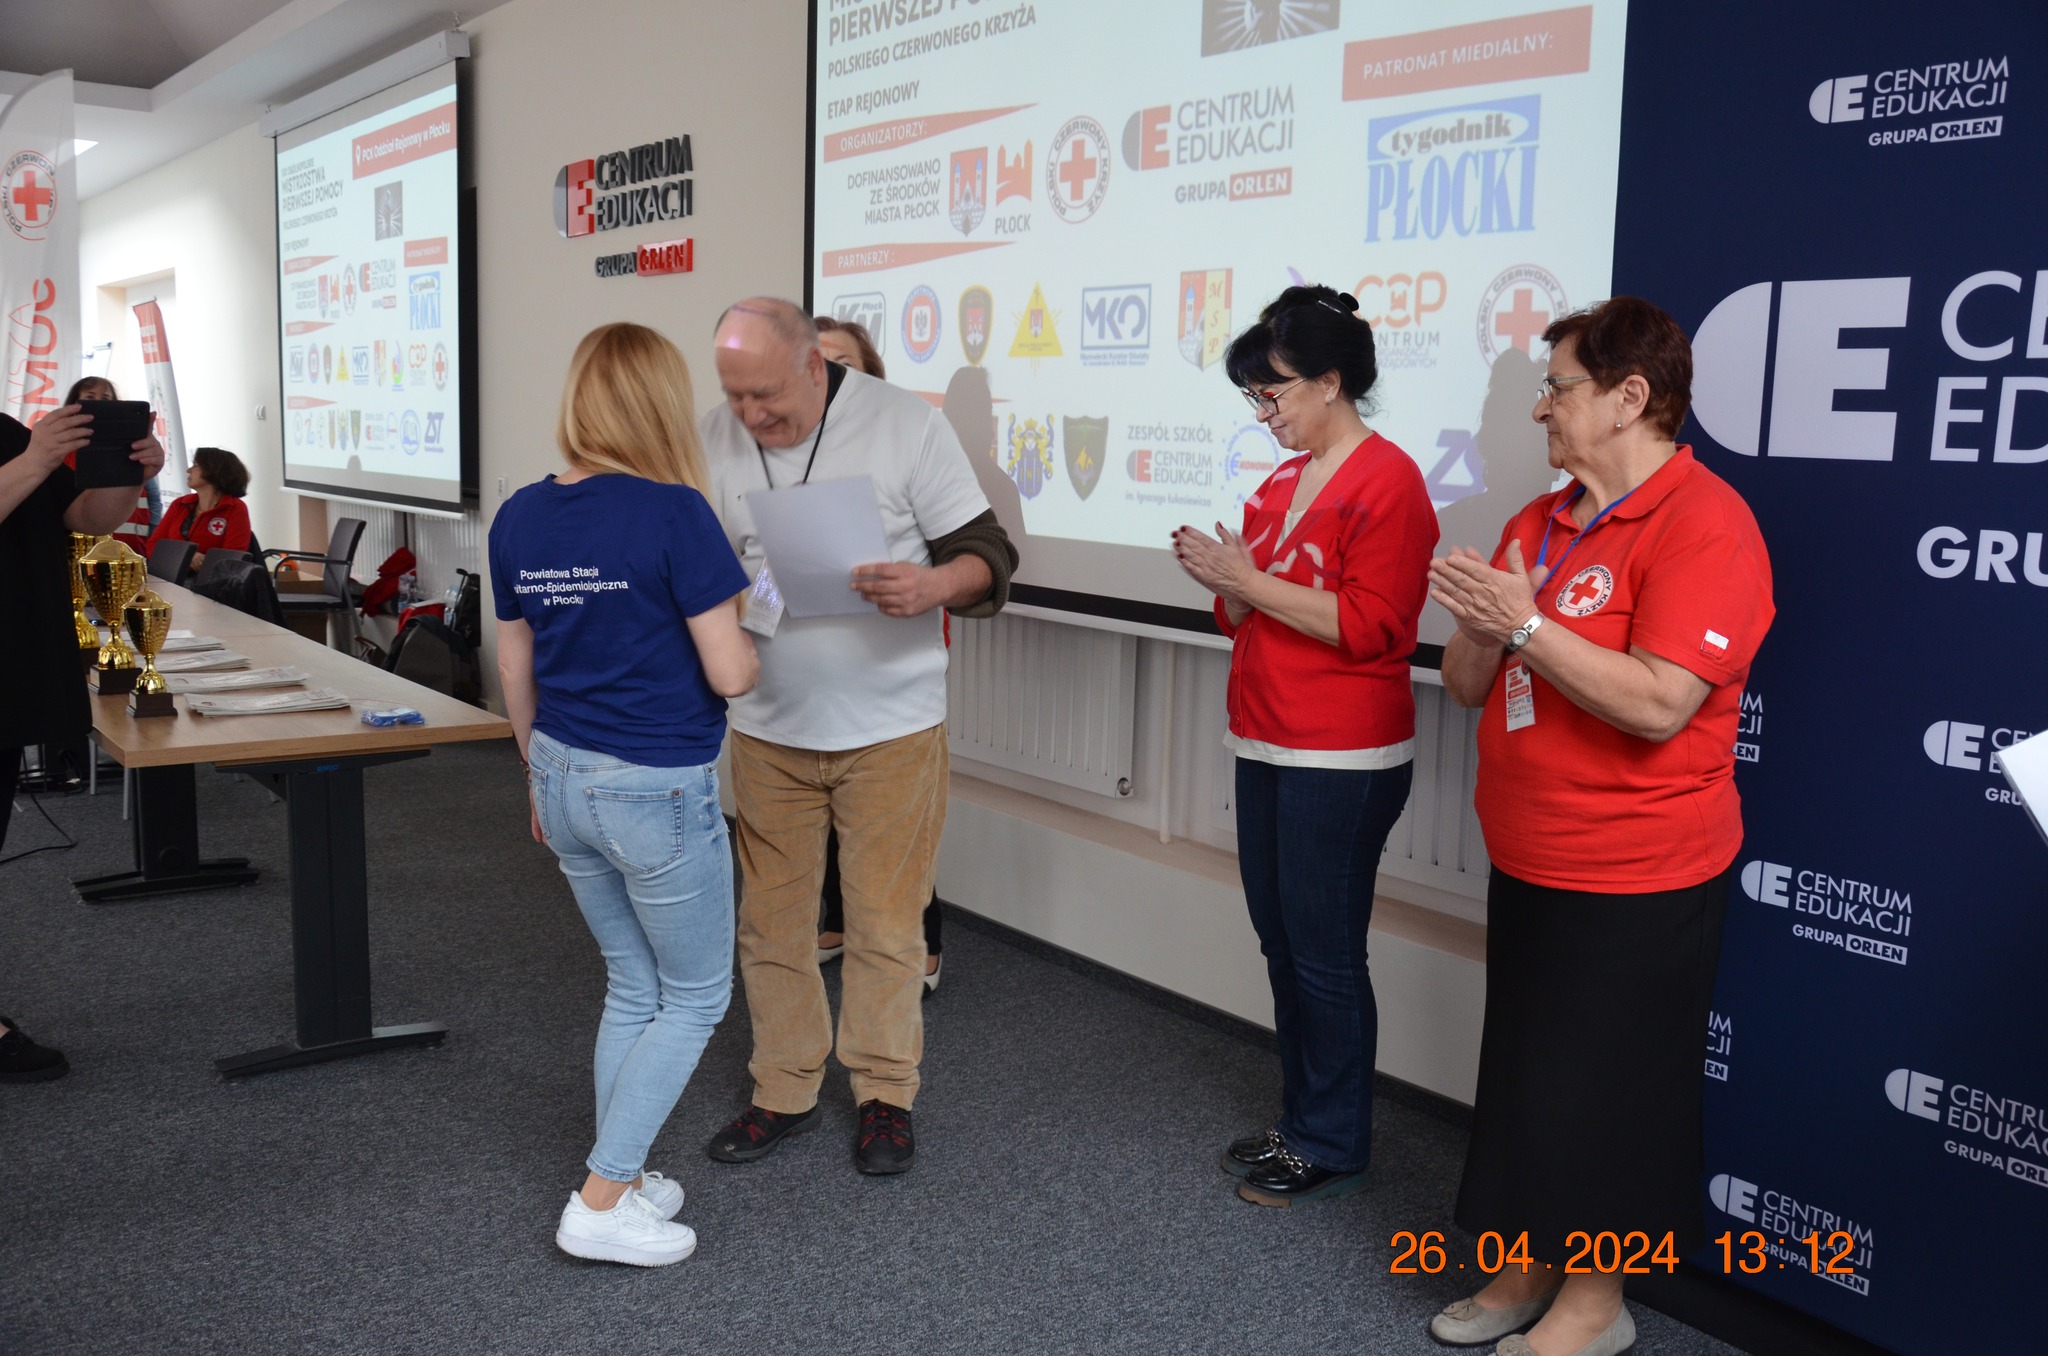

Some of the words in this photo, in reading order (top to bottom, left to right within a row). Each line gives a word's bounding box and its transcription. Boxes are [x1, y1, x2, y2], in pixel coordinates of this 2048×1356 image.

[828, 46, 890, 79] POLSKIEGO
[892, 20, 981, 61] CZERWONEGO
[984, 2, 1036, 37] KRZYŻA
[1363, 49, 1447, 80] PATRONAT
[1452, 32, 1554, 64] MIEDIALNY:
[1874, 55, 2009, 94] CENTRUM
[827, 96, 853, 120] ETAP
[855, 80, 920, 114] REJONOWY
[1177, 83, 1295, 131] CENTRUM
[1871, 81, 2007, 118] EDUKACJI
[840, 119, 928, 152] ORGANIZATORZY:
[1054, 120, 1107, 151] CZERWONY
[1176, 118, 1293, 165] EDUKACJI
[1391, 112, 1512, 157] tygodnik
[1868, 128, 1928, 146] GRUPA
[1934, 119, 1997, 140] ORLEN
[595, 134, 693, 190] CENTRUM
[847, 158, 941, 190] DOFINANSOWANO
[282, 166, 326, 194] MISTRZOSTWA
[282, 188, 314, 213] PIERWSZEJ
[315, 179, 344, 203] POMOCY
[869, 188, 883, 205] ZE
[885, 177, 940, 203] ŚRODKÓW
[1048, 161, 1067, 216] POLSKI
[1175, 180, 1227, 204] GRUPA
[1232, 172, 1287, 196] ORLEN
[1364, 144, 1540, 244] PŁOCKI
[595, 179, 693, 231] EDUKACJI
[864, 206, 901, 226] MIASTA
[903, 200, 940, 220] PŁOCK
[994, 214, 1031, 235] PŁOCK
[595, 252, 637, 277] GRUPA
[639, 244, 685, 271] ORLEN
[1493, 268, 1558, 293] CZERWONY
[1376, 331, 1440, 347] NTRUM
[1127, 421, 1170, 442] ZESPÓŁ
[1173, 424, 1213, 443] SZKÓŁ
[1154, 451, 1213, 469] CENTRUM
[1154, 467, 1212, 487] EDUKACJI
[520, 568, 571, 580] Powiatowa
[572, 566, 599, 578] Stacja
[543, 598, 550, 606] w
[552, 594, 584, 606] Płocku
[1797, 870, 1912, 914] CENTRUM
[1795, 891, 1911, 936] EDUKACJI
[1792, 924, 1844, 947] GRUPA
[1849, 937, 1903, 962] ORLEN
[1944, 1140, 2004, 1170] GRUPA
[1763, 1190, 1874, 1248] CENTRUM
